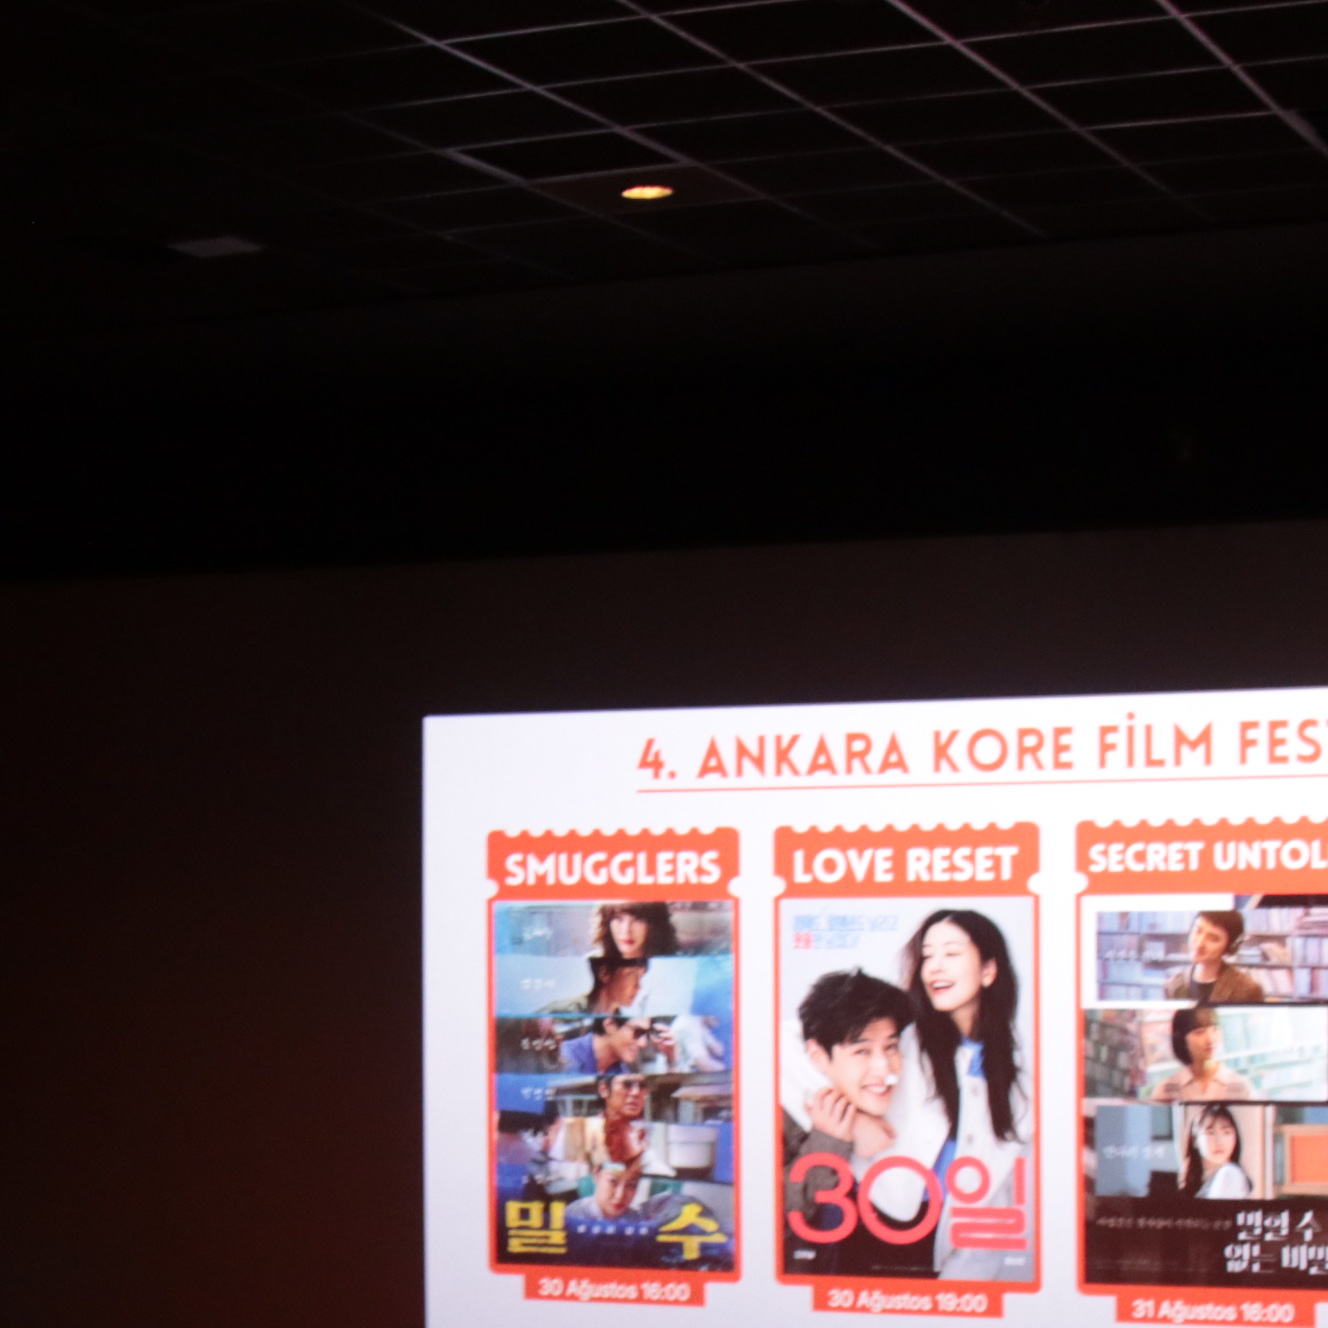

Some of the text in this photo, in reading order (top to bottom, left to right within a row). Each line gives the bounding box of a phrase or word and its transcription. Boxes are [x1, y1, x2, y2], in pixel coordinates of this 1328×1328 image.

[637, 737, 677, 780] 4.
[696, 732, 910, 778] ANKARA
[932, 727, 1074, 773] KORE
[1098, 712, 1213, 769] FİLM
[505, 850, 721, 886] SMUGGLERS
[792, 846, 1019, 884] LOVE RESET
[1088, 841, 1205, 873] SECRET
[787, 1152, 1029, 1250] 30일
[505, 1200, 728, 1261] 밀 수
[538, 1277, 564, 1296] 30
[565, 1278, 639, 1302] Ağustos
[827, 1288, 855, 1308] 30
[856, 1289, 933, 1313] Ağustos
[1132, 1299, 1155, 1319] 31
[1157, 1299, 1238, 1323] Ağustos
